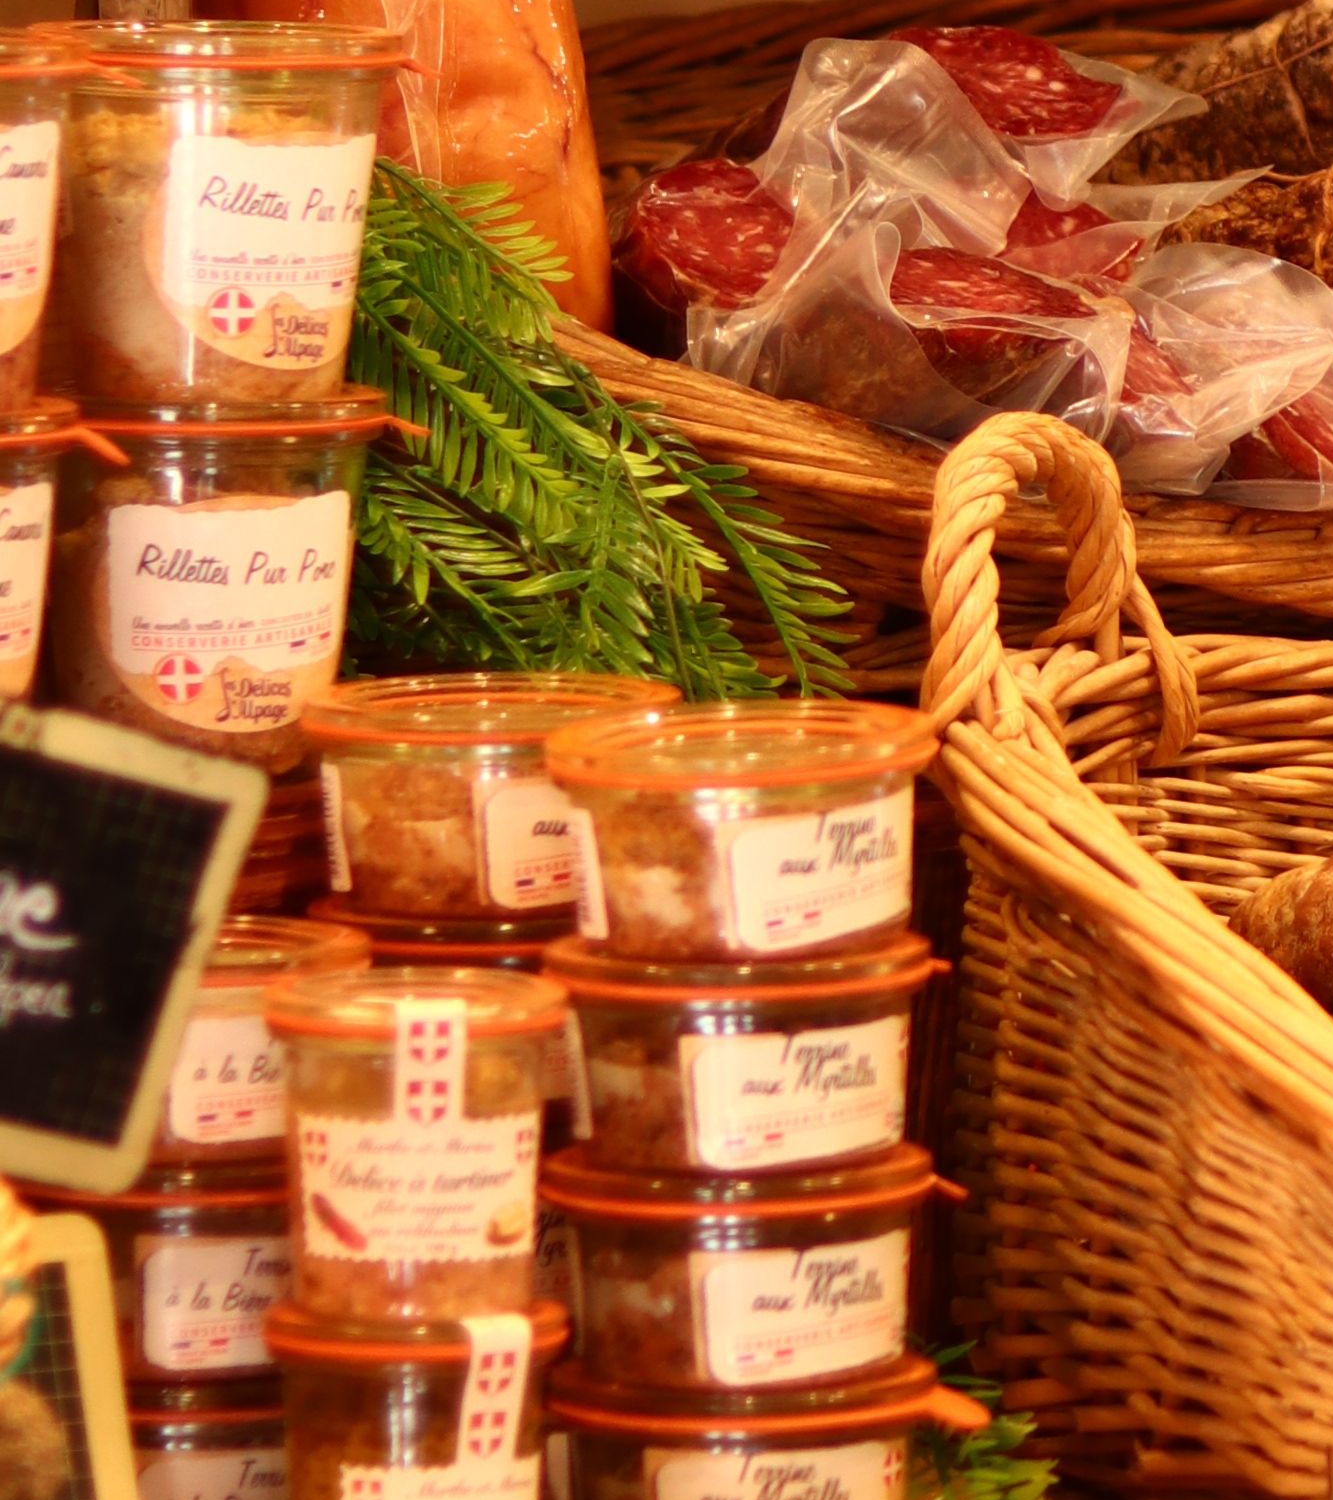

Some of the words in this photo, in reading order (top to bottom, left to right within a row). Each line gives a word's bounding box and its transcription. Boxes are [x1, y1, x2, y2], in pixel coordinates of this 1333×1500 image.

[199, 175, 291, 222] Rillettes
[301, 187, 336, 222] Pur
[135, 543, 231, 586] Rillettes
[243, 550, 289, 586] Pur
[297, 548, 337, 583] Porc
[131, 634, 248, 650] CONSERVERIE
